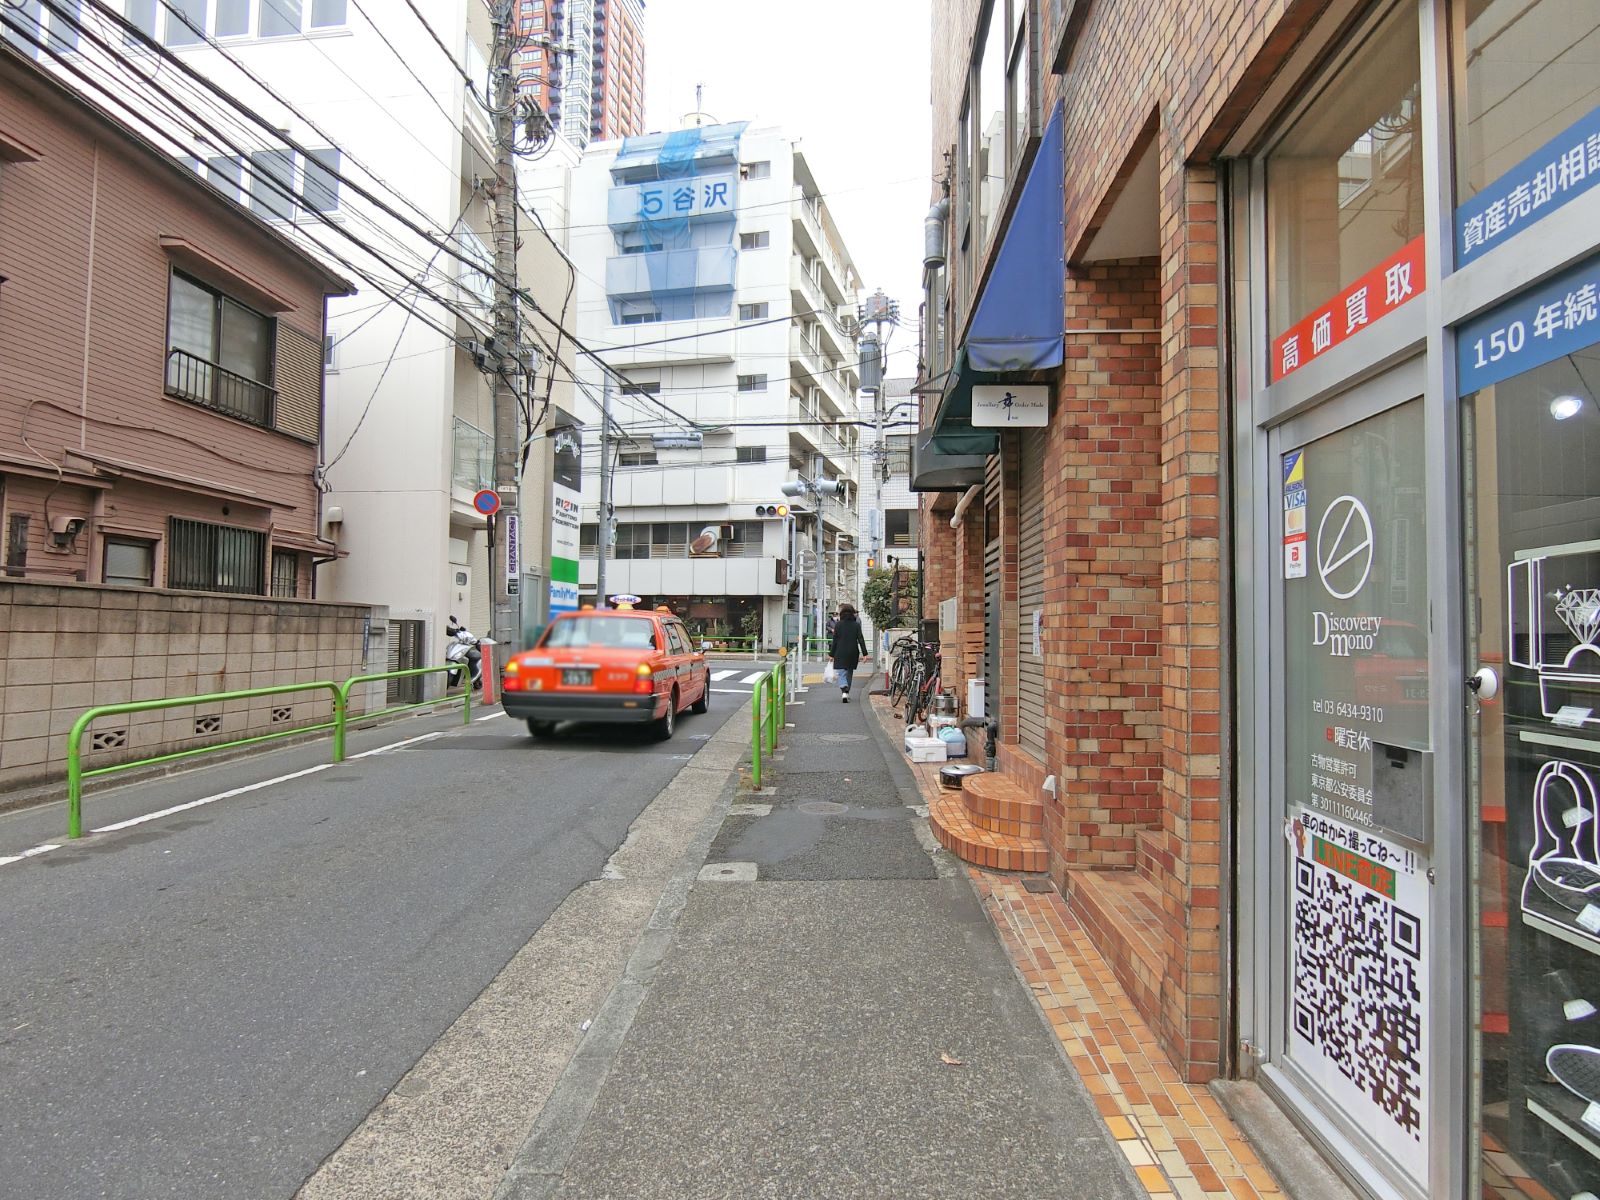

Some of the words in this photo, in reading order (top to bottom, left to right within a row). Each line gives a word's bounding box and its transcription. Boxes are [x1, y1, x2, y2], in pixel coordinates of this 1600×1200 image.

[1281, 261, 1412, 374] 高価買取
[1286, 491, 1305, 509] VISA
[550, 585, 578, 600] FamilyMart
[1312, 611, 1382, 646] Discovery
[1329, 633, 1374, 657] mono
[1312, 698, 1323, 713] tel
[1324, 700, 1334, 715] 03
[1336, 702, 1384, 723] 6434-9310
[1310, 753, 1357, 779] 古物営業許可
[1311, 773, 1373, 806] 東京都公安委員会
